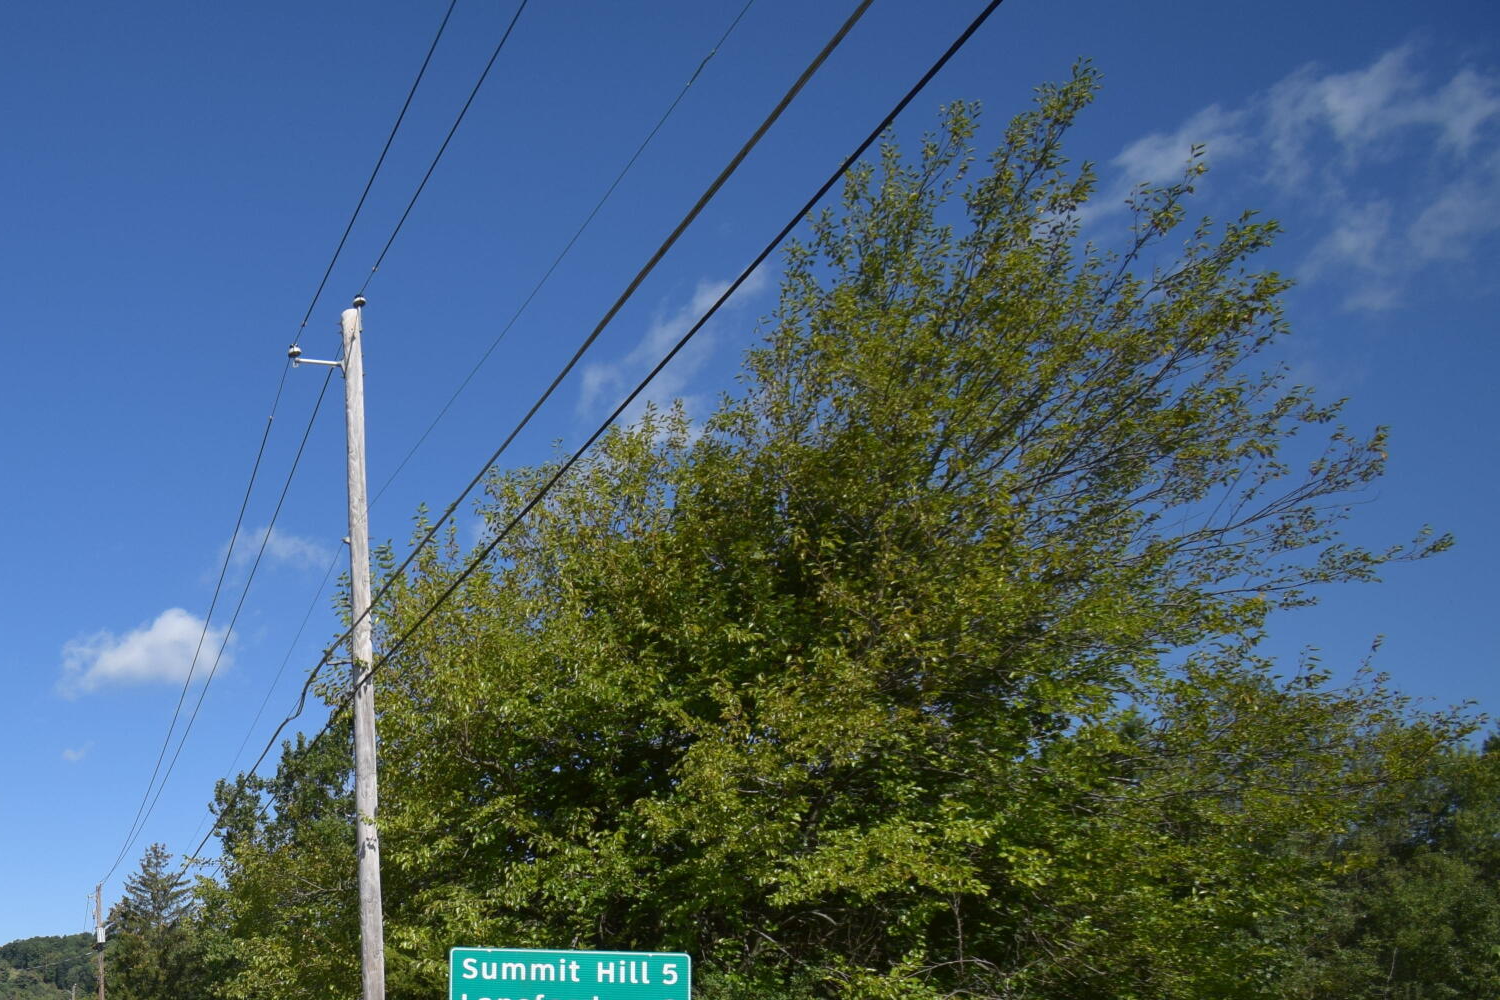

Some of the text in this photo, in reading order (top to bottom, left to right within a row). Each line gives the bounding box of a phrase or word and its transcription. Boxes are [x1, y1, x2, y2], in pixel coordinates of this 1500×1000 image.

[461, 957, 678, 985] Summit Hill 5
